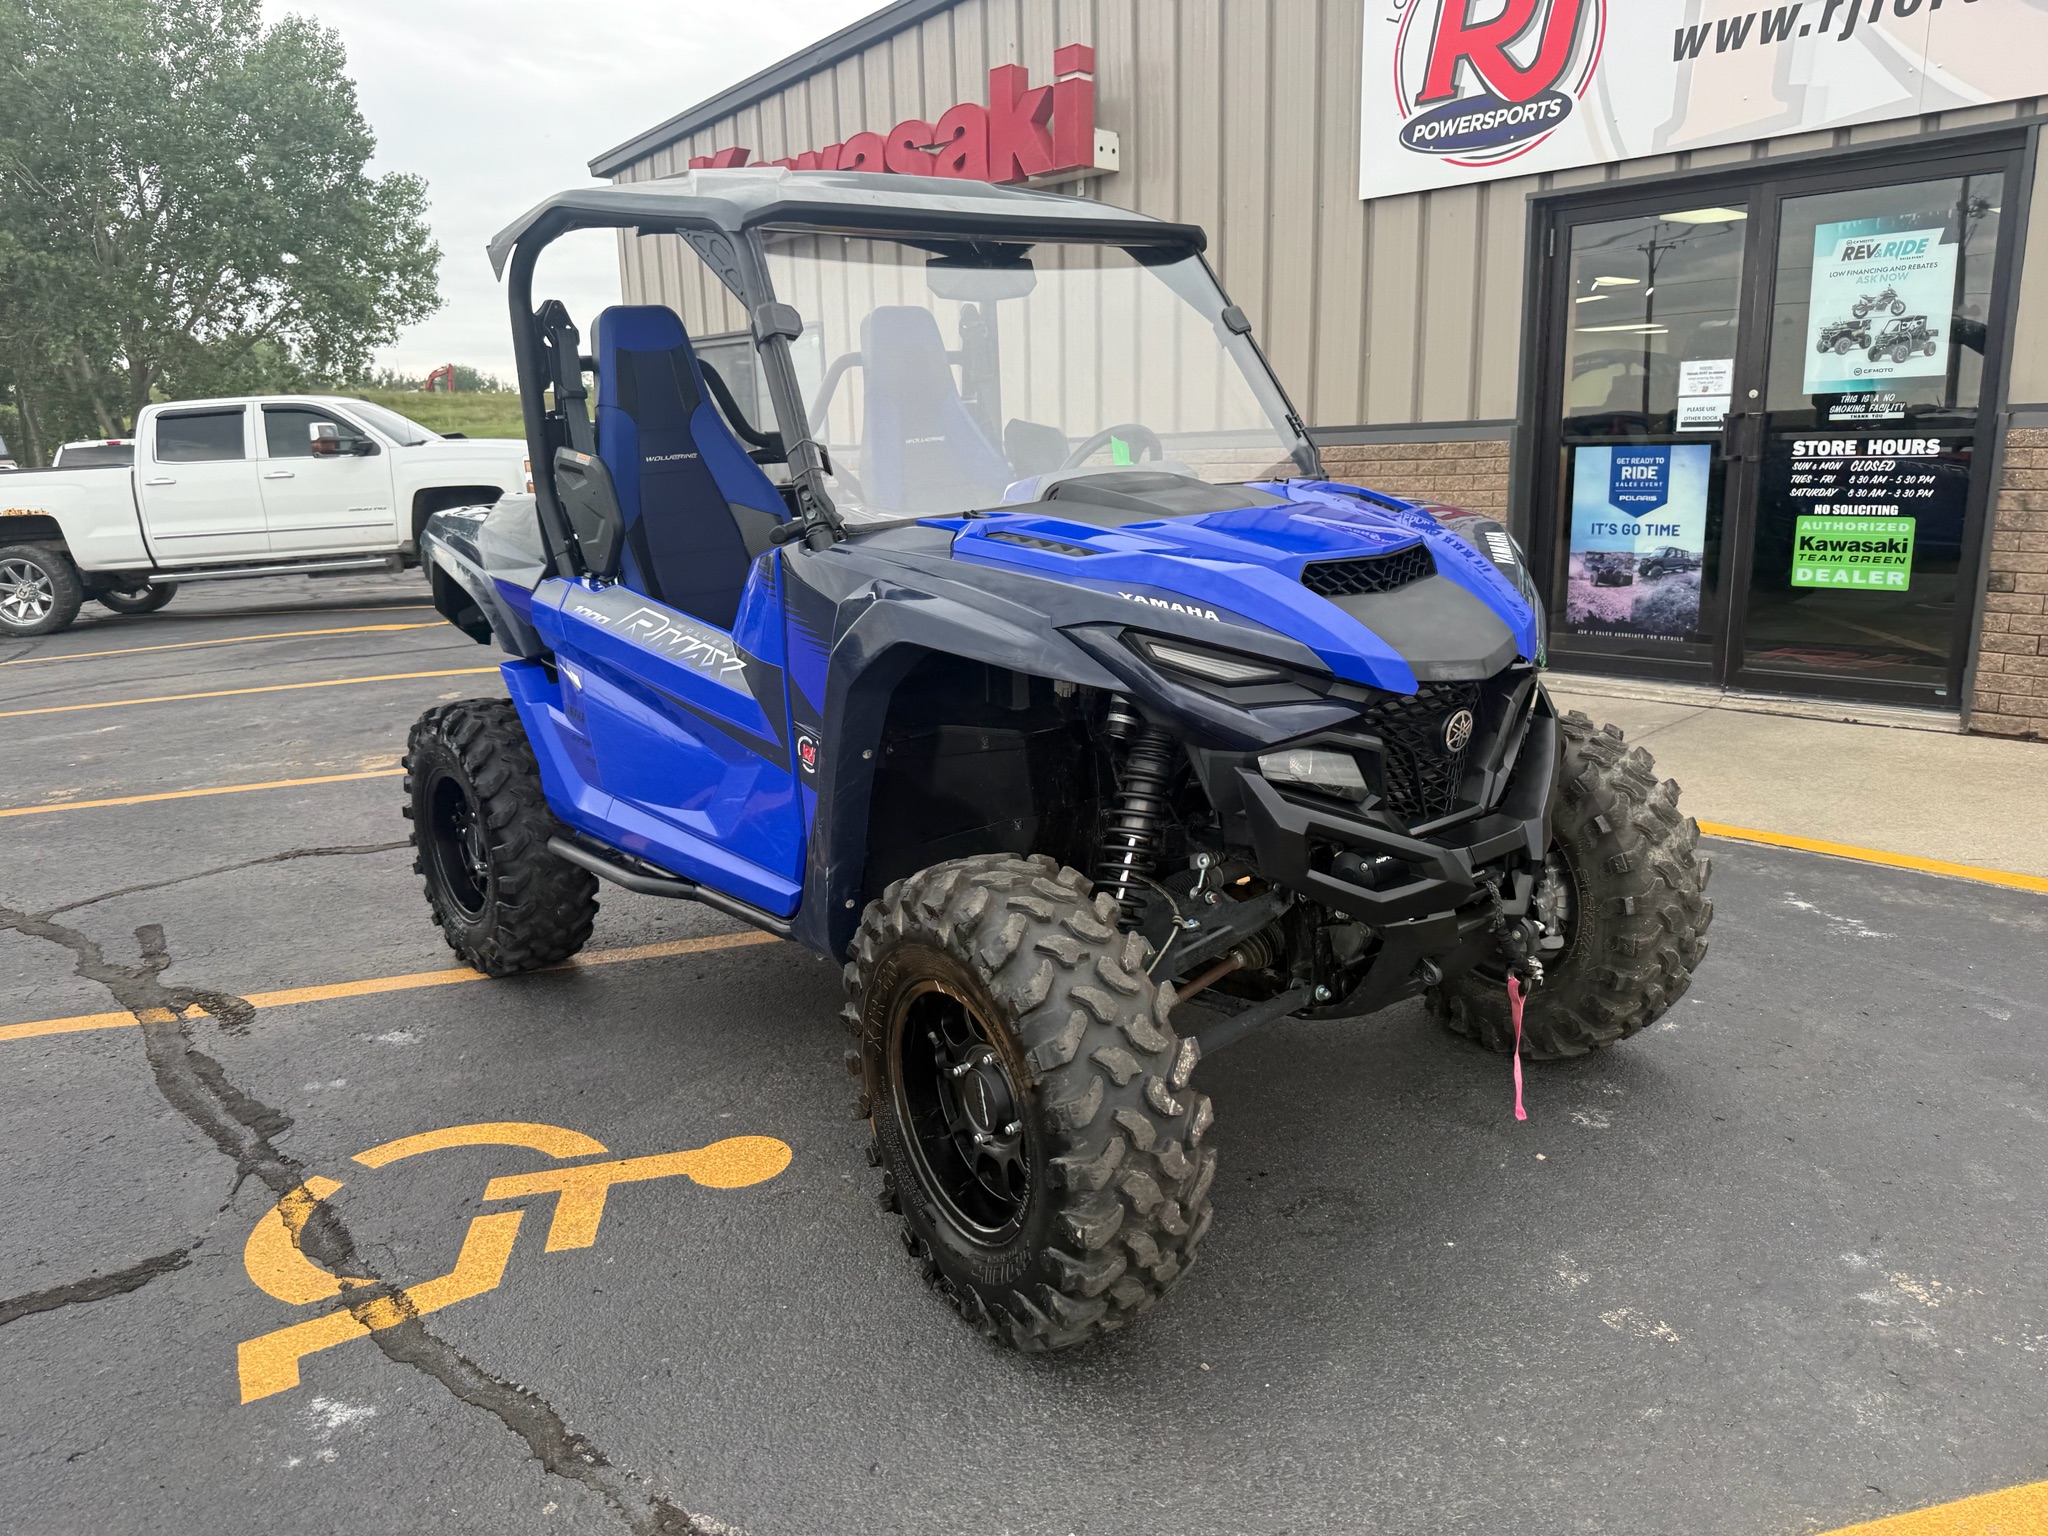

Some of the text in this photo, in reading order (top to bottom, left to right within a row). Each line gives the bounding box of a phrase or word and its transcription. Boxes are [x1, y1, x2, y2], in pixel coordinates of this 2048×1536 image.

[1414, 0, 1585, 106] RJ
[1411, 98, 1563, 143] POWERSPORTS
[1829, 261, 1939, 278] LOW FINANCING AND REBATES
[1856, 272, 1910, 284] ASK NOW
[1840, 393, 1896, 403] THIS IS A NO
[1829, 402, 1906, 413] SMOKING FACILITY
[1792, 438, 1941, 456] STORE HOURS
[645, 452, 698, 462] WOLVERINE
[1616, 456, 1665, 465] GET READY TO
[1621, 465, 1659, 480] RIDE
[1791, 461, 1813, 471] SUN
[1818, 461, 1844, 471] MON
[1850, 459, 1897, 472] CLOSED
[1790, 474, 1813, 484] TUES
[1819, 475, 1837, 484] FRI
[1869, 475, 1888, 484] AM
[1917, 475, 1936, 484] PM
[1789, 487, 1839, 497] SATURDAY
[1867, 488, 1887, 498] AM
[1915, 489, 1935, 498] PM
[1814, 504, 1899, 516] NO SOLICITING
[1591, 522, 1681, 537] IT'S GO TIME
[1801, 521, 1910, 532] AUTHORIZED
[1484, 531, 1516, 565] YAMAHA
[1799, 535, 1909, 554] Kawasaki
[1798, 553, 1906, 565] TEAM GREEN
[1796, 567, 1905, 586] DEALER
[1117, 591, 1220, 622] YAMAHA
[571, 605, 612, 626] 1000
